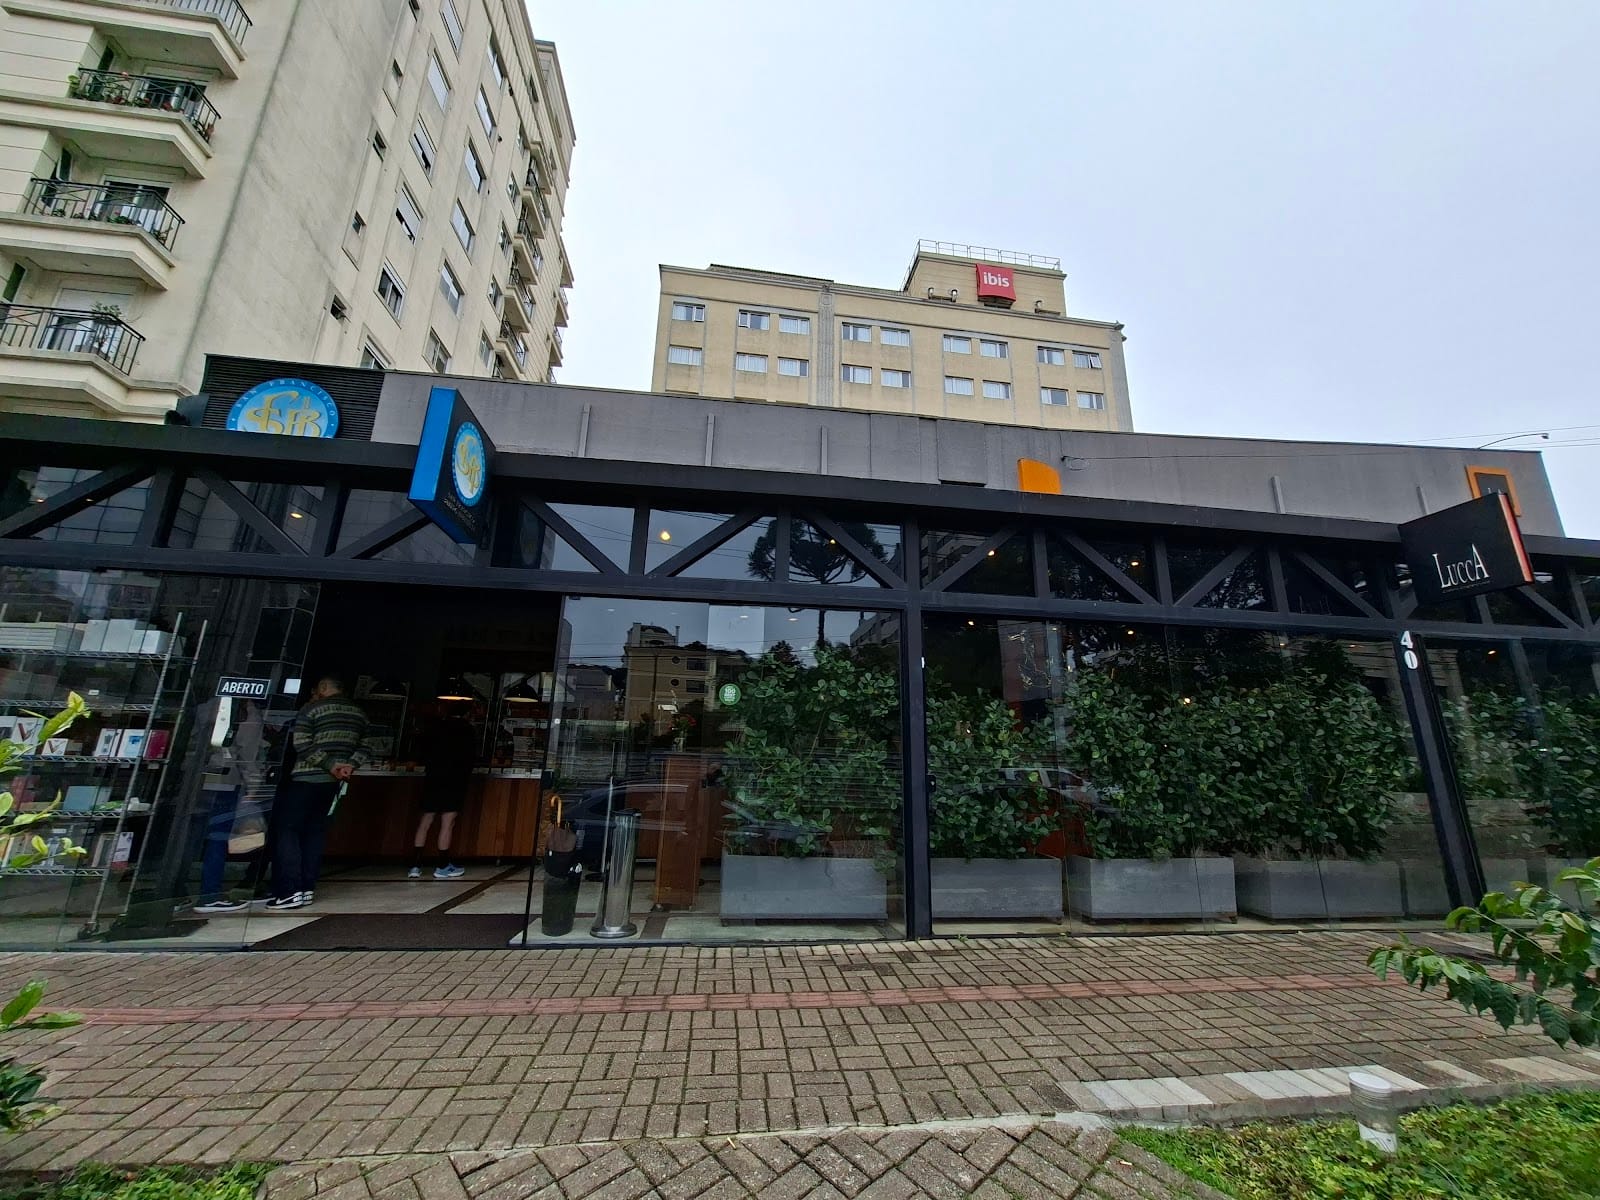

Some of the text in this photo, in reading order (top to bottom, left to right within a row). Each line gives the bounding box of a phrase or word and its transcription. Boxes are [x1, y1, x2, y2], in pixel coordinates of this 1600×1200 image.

[983, 272, 1010, 288] ibis
[268, 379, 337, 416] FRANCISCO
[1400, 630, 1418, 670] 40
[221, 681, 265, 695] ABERTO
